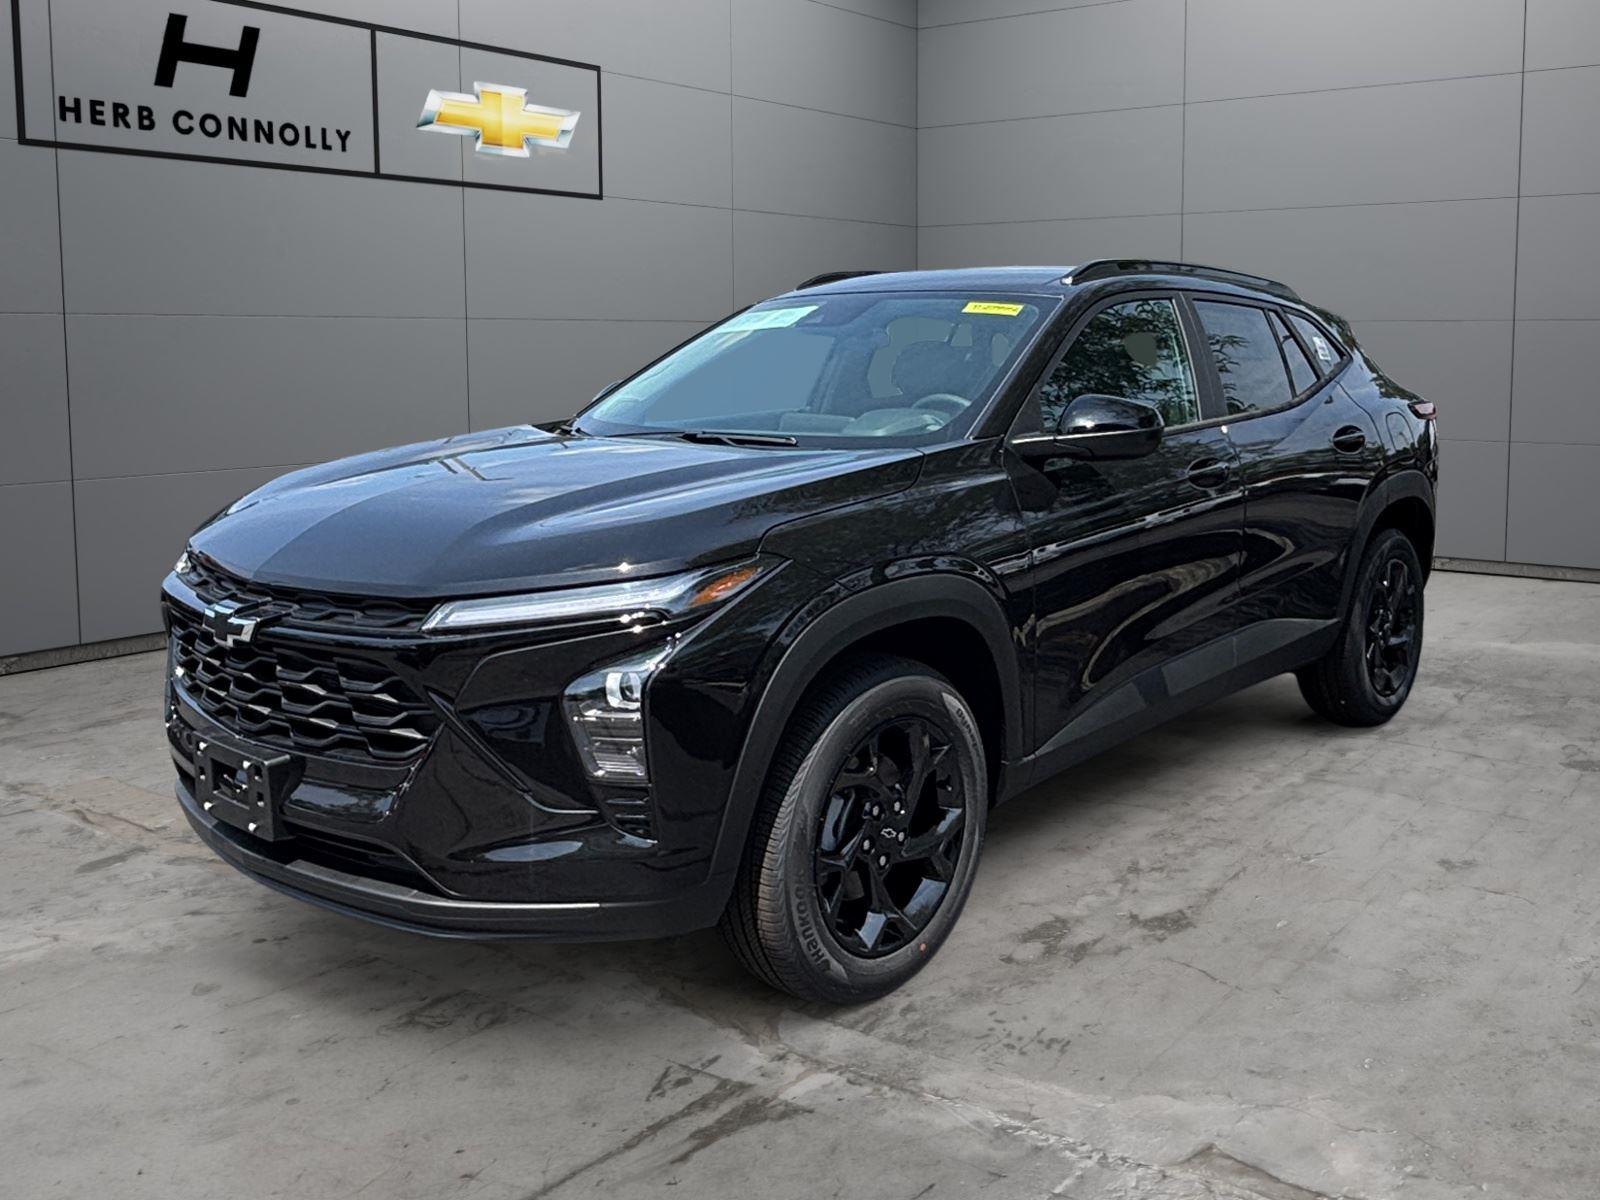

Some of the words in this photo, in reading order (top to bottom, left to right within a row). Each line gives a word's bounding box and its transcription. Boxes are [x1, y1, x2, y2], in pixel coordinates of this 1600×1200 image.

[154, 13, 260, 97] H
[58, 95, 156, 132] HERB
[172, 109, 351, 153] CONNOLLY
